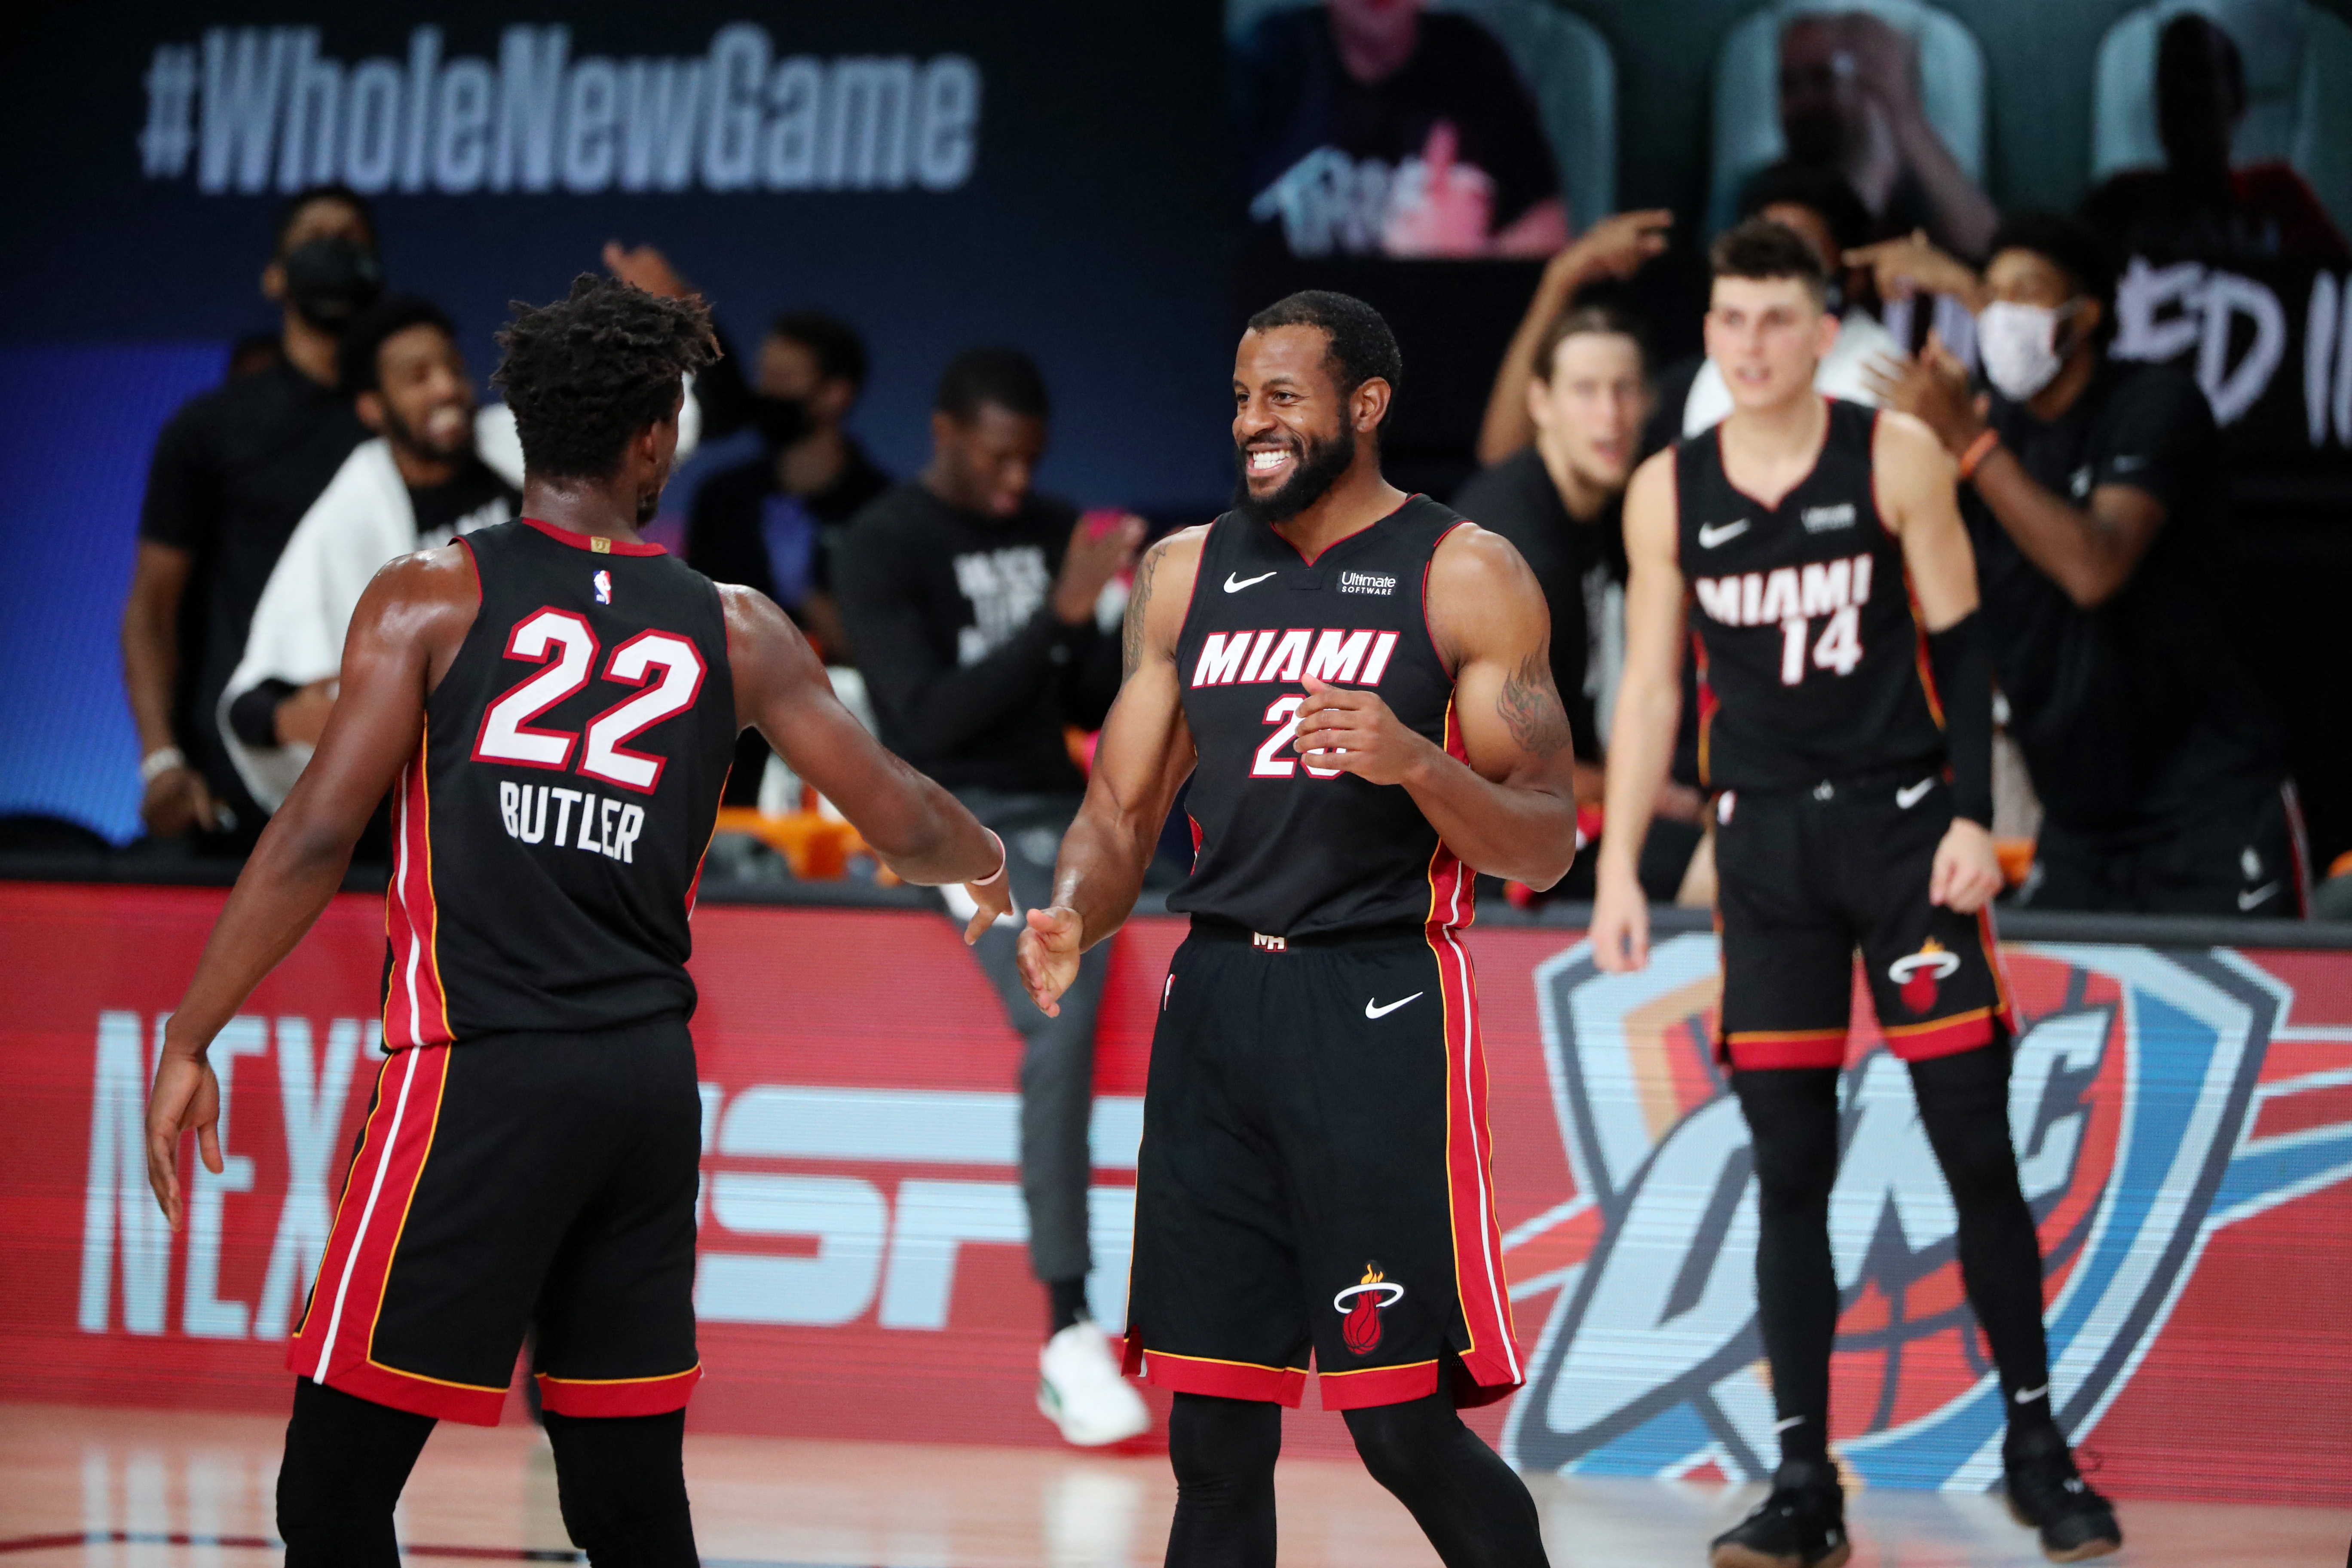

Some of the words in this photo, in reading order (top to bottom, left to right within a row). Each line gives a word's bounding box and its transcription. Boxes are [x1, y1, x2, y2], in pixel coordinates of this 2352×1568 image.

[140, 22, 980, 195] #WholeNewGame
[1341, 571, 1396, 588] Ultimate
[1341, 586, 1392, 595] SOFTWARE
[1695, 553, 1873, 627] MIAMI
[1190, 628, 1400, 689] MIAMI
[1779, 603, 1864, 686] 14
[470, 605, 708, 795] 22
[500, 780, 645, 864] BUTLER
[78, 1010, 383, 1341] NEX
[694, 1082, 1147, 1337] SP
